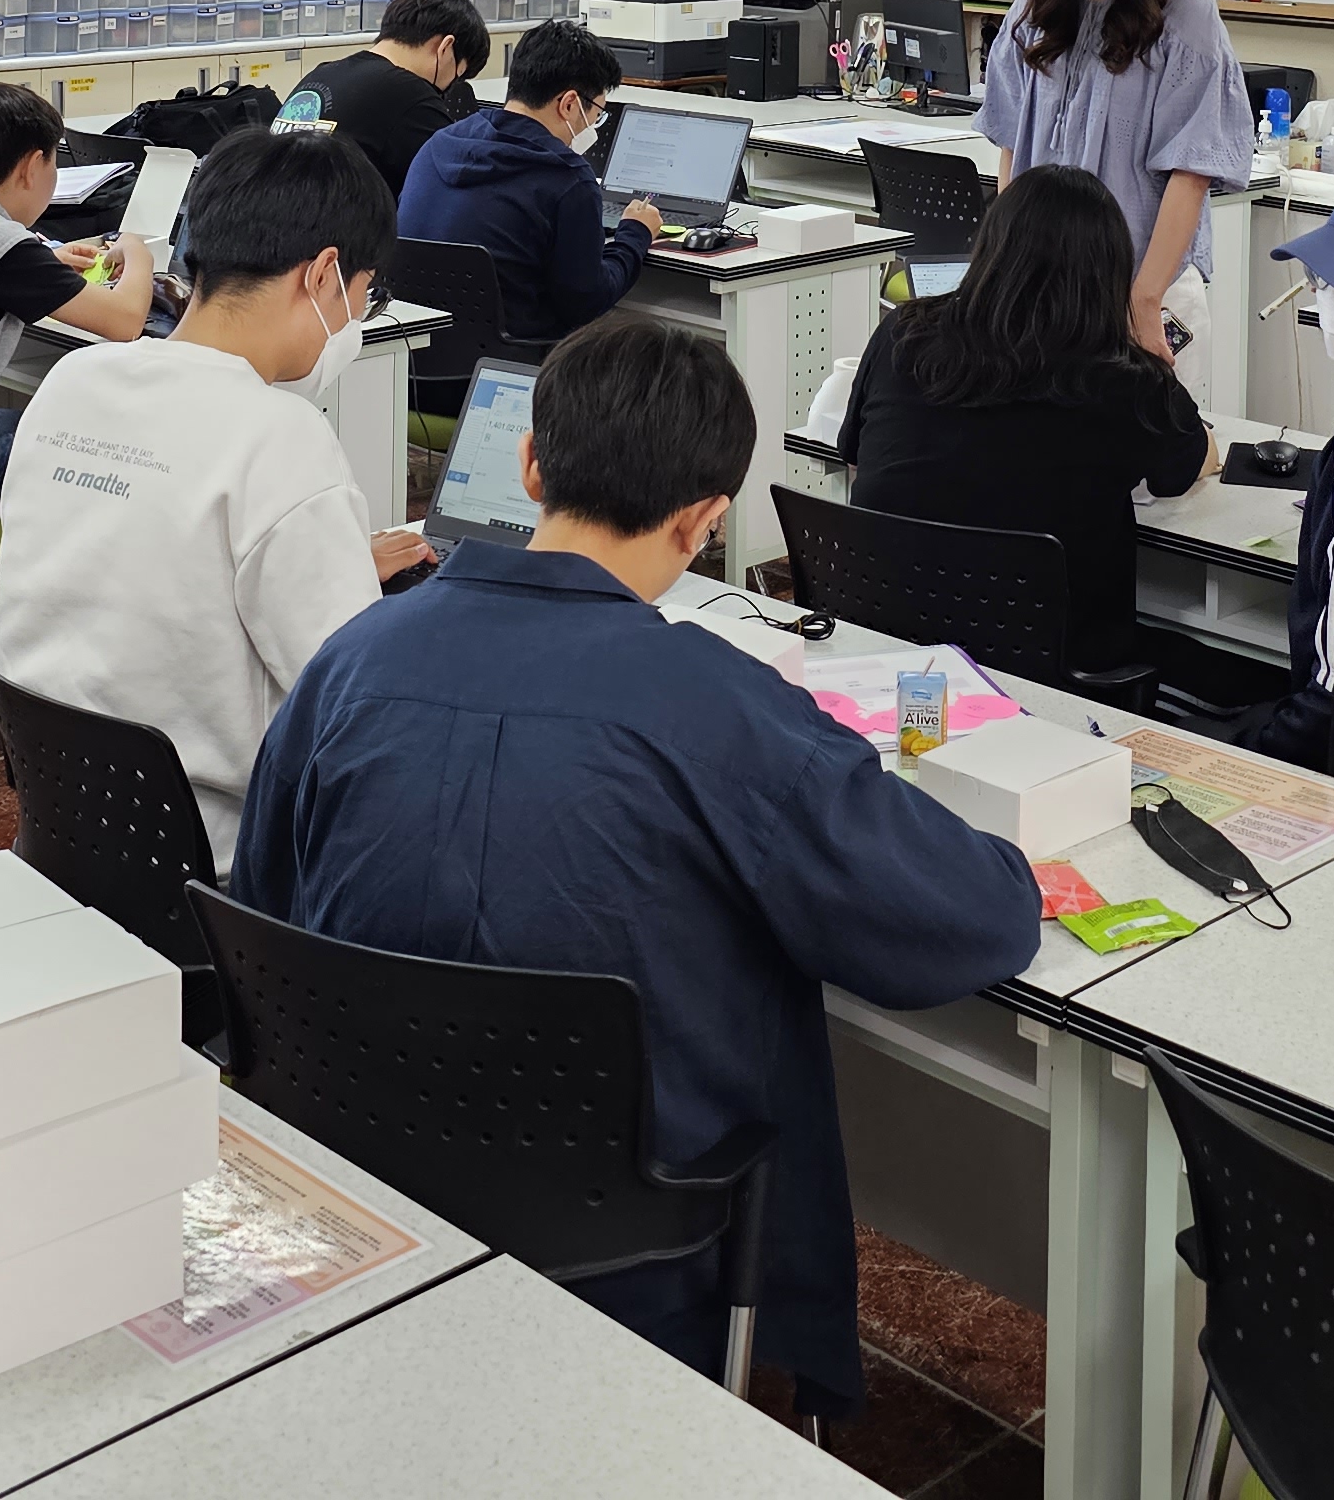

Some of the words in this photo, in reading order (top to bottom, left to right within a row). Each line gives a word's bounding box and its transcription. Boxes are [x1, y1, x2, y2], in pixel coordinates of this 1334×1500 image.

[36, 433, 48, 443] BUT
[49, 437, 64, 449] TAKE
[66, 442, 99, 457] COURAGE
[111, 452, 125, 462] CAN
[56, 430, 69, 441] LIFE
[70, 434, 78, 443] IS
[80, 436, 96, 447] NOT
[96, 439, 120, 451] MEANT
[121, 445, 130, 454] TO
[131, 447, 139, 456] BE
[52, 466, 76, 484] no
[75, 472, 131, 501] matter,
